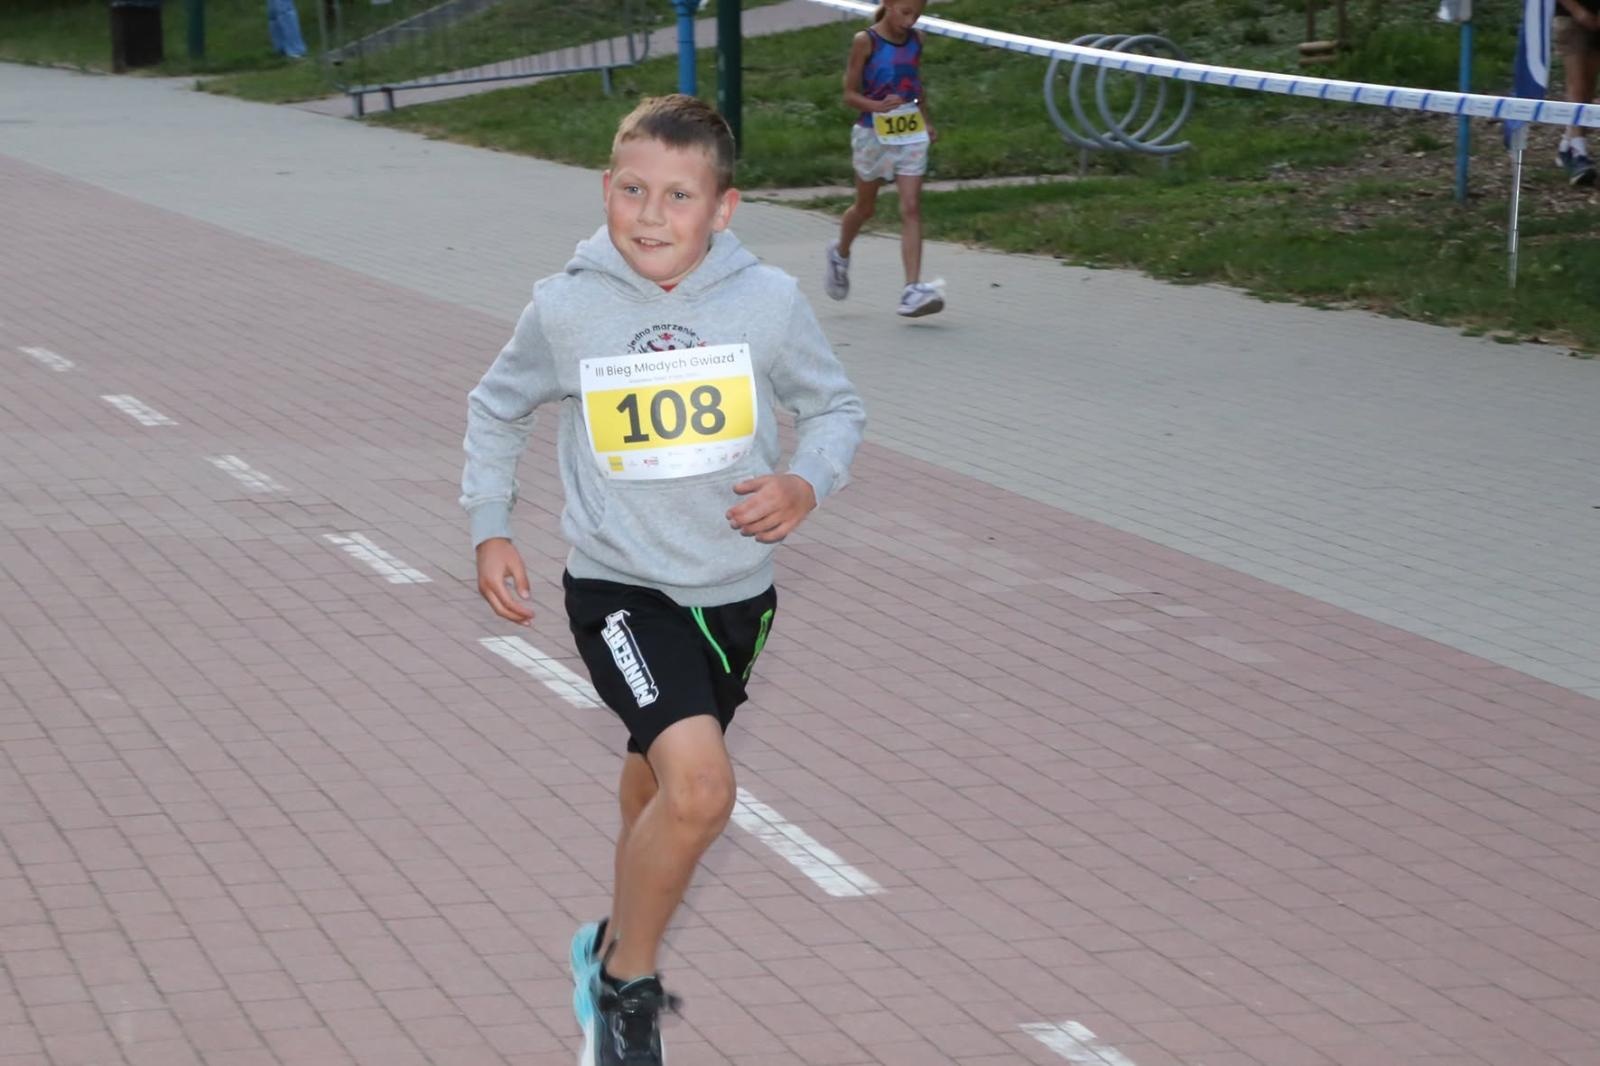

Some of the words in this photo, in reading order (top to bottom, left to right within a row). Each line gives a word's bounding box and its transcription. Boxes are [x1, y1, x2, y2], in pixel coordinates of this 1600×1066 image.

[884, 113, 918, 134] 106
[595, 366, 604, 377] III
[606, 364, 631, 378] Bieg
[634, 358, 687, 373] Młodych
[690, 353, 735, 367] Gwiazd
[615, 384, 726, 444] 108
